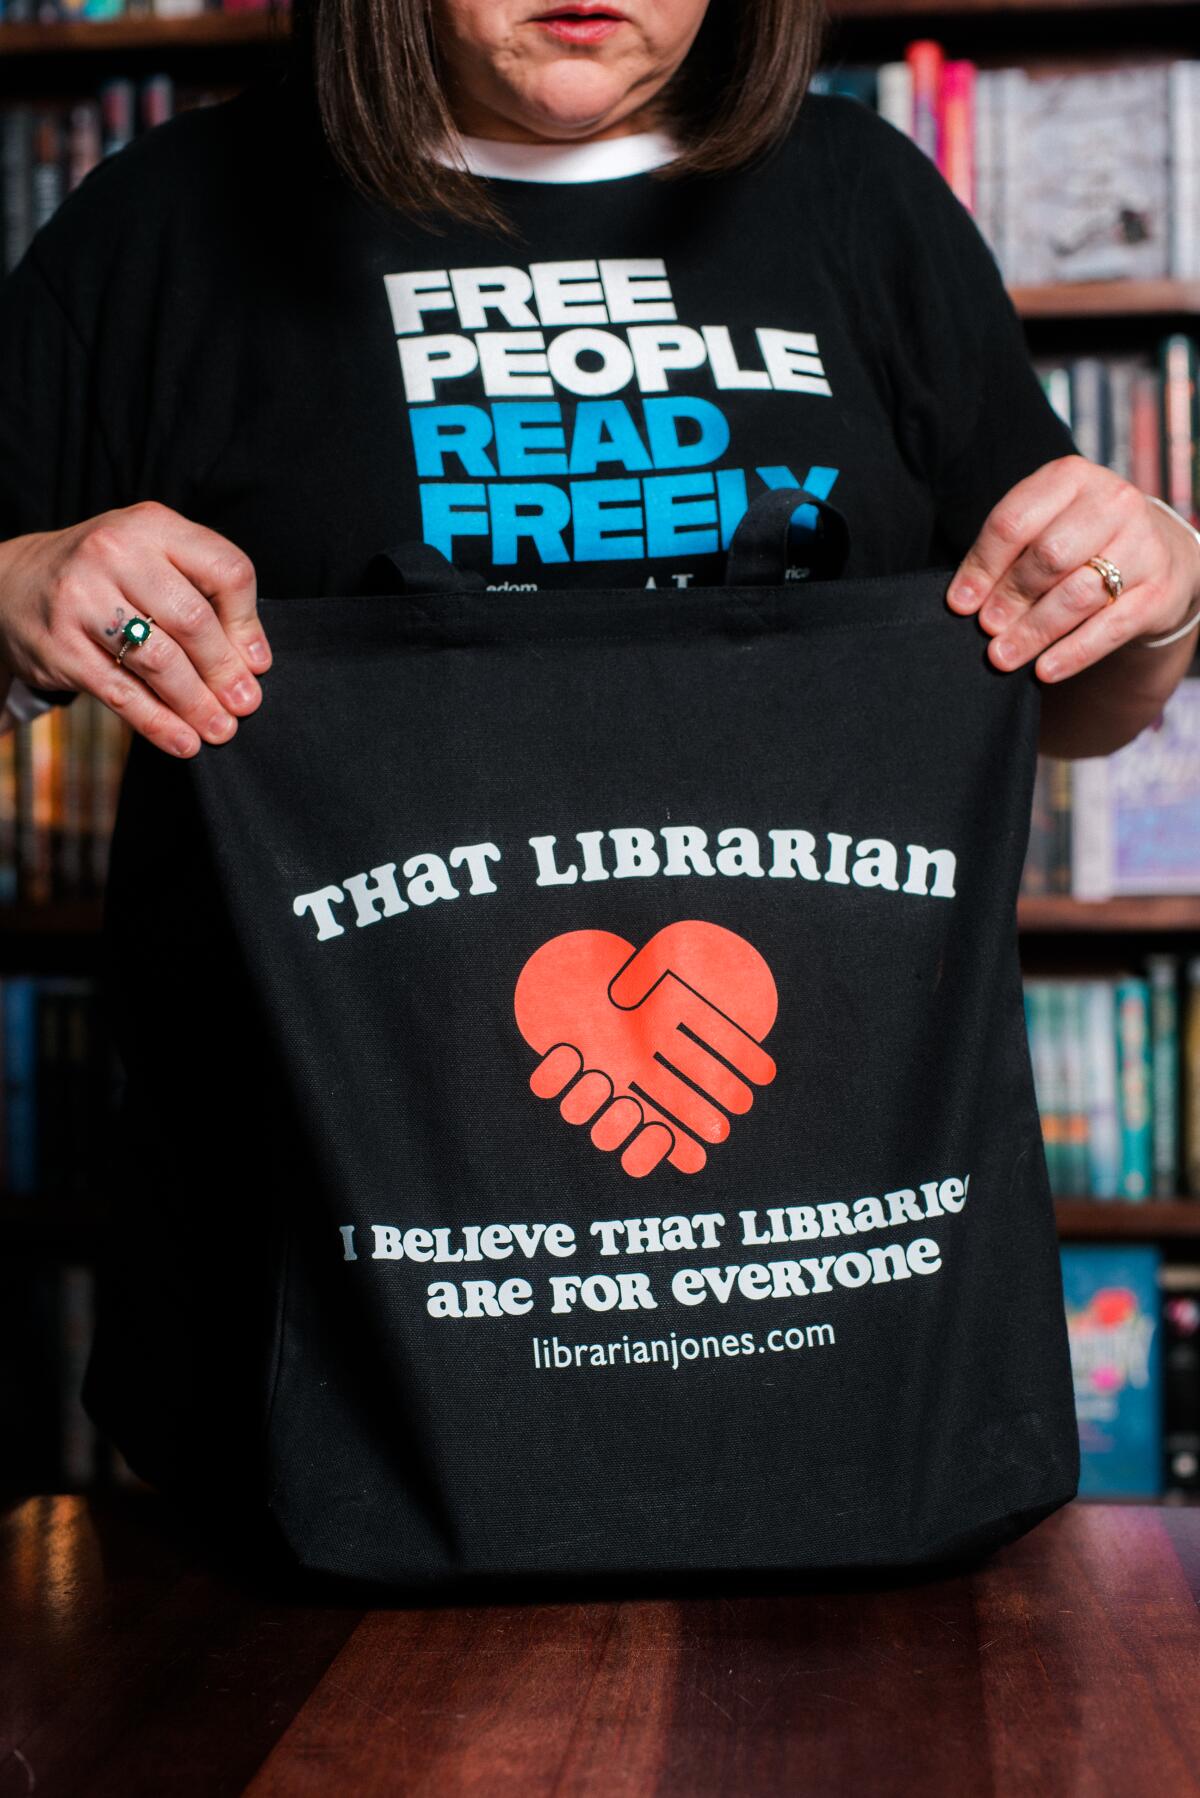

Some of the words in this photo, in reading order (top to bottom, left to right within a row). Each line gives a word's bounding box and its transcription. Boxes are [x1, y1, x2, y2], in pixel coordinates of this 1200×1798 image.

[384, 259, 677, 335] FREE
[397, 325, 832, 403] PEOPLE
[409, 396, 730, 477] READ
[485, 581, 538, 592] edom
[339, 1225, 357, 1261] I
[549, 1273, 658, 1314] FOR
[533, 1323, 835, 1371] librarianjones.com
